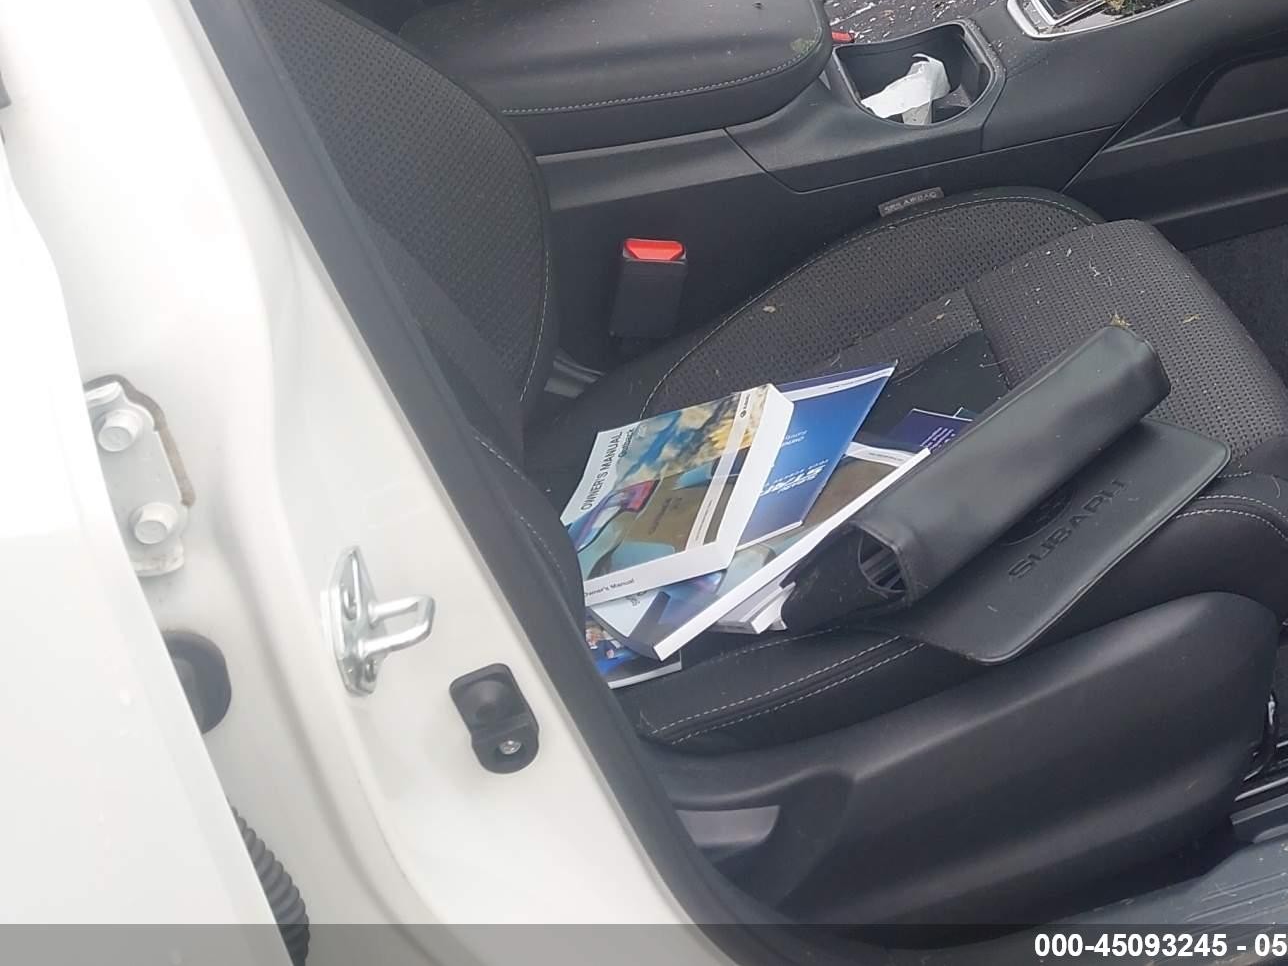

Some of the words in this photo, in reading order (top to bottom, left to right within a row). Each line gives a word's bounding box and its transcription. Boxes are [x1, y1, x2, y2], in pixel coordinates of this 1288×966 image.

[580, 471, 609, 510] OWNER'S
[600, 431, 623, 471] MANUAL
[1007, 478, 1126, 579] SUBARU
